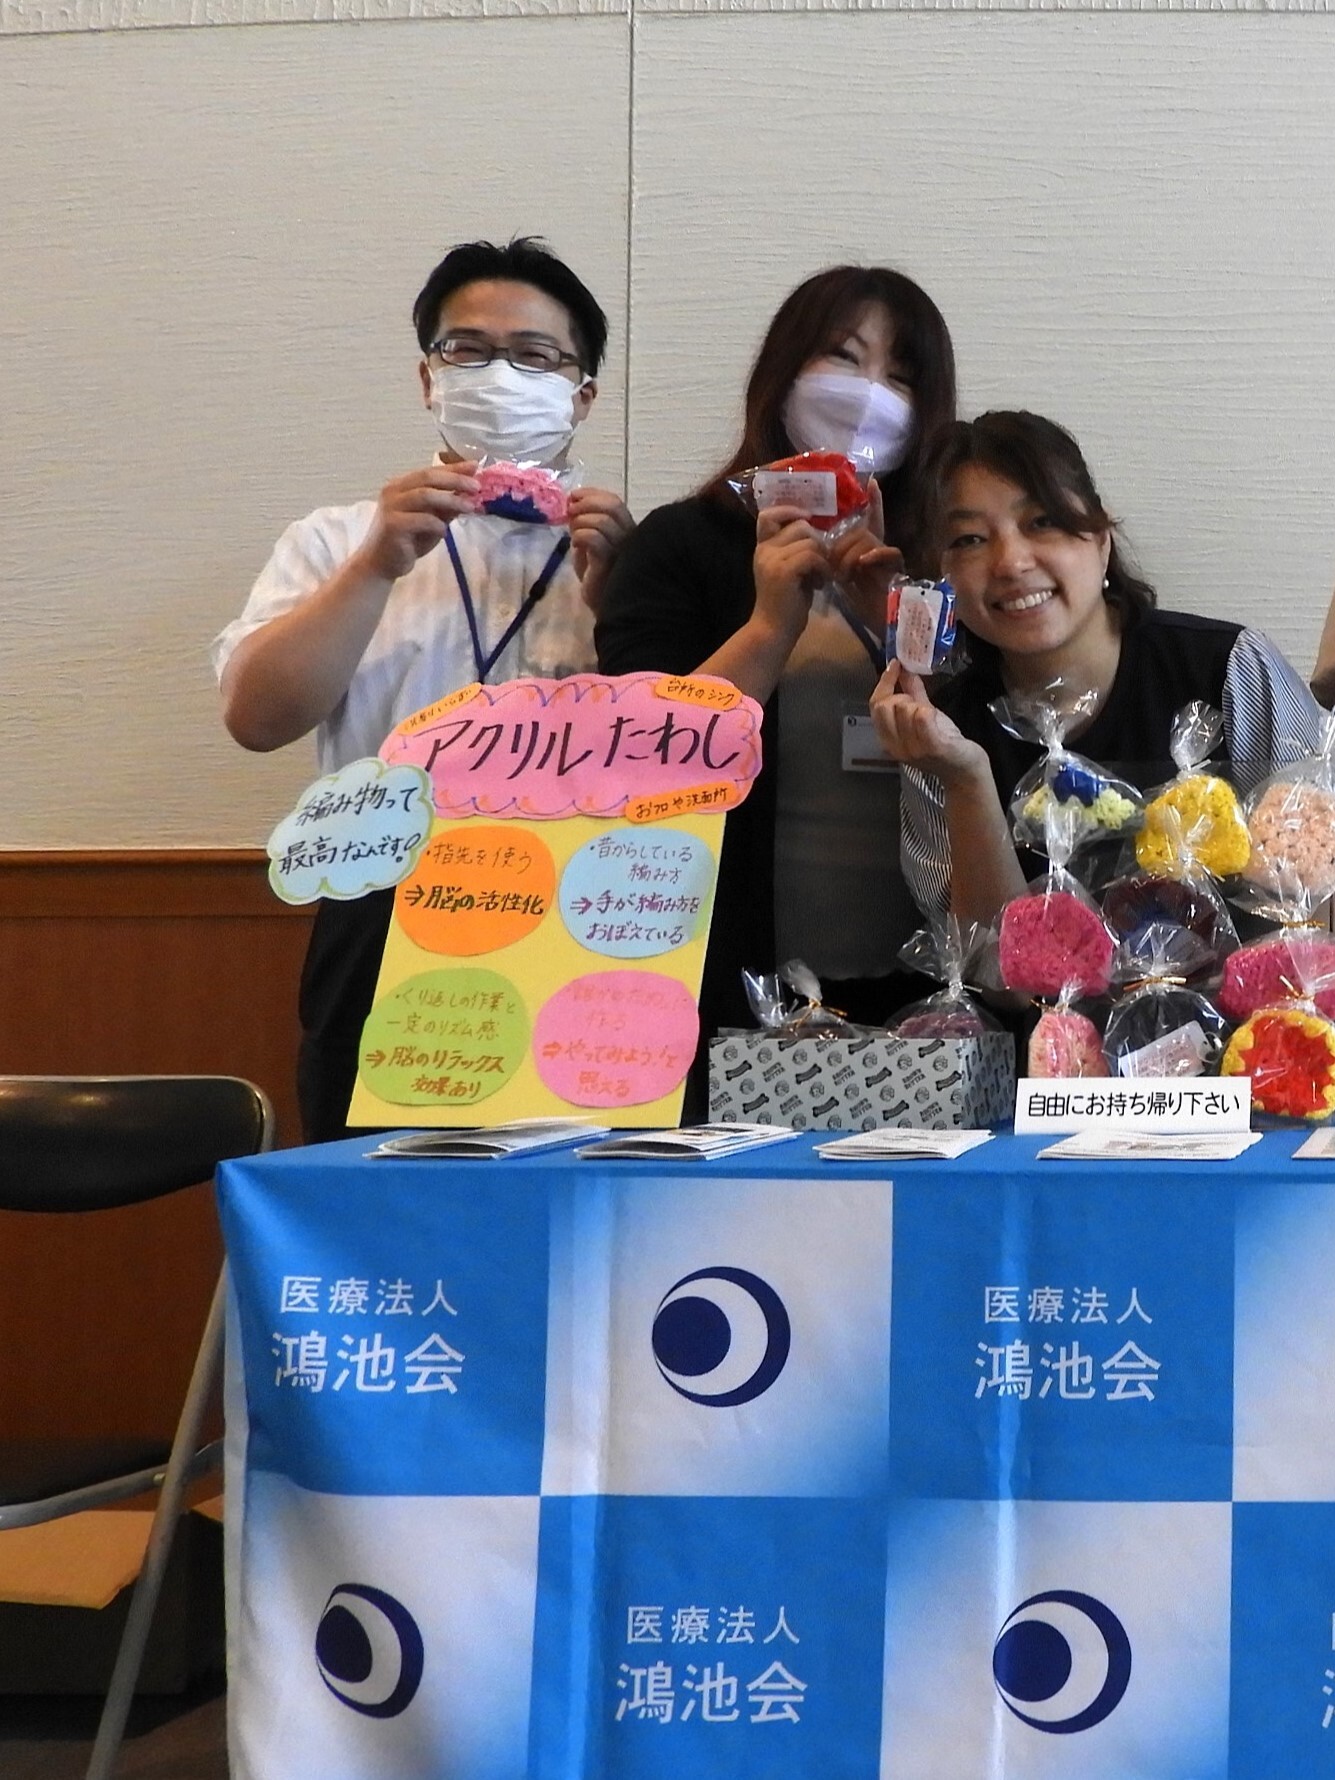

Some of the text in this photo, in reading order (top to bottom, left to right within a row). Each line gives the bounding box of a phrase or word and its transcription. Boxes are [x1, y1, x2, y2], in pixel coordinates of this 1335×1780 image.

[297, 782, 418, 825] 編み物って
[1028, 1091, 1240, 1117] 自由にお持ち帰り下さい
[280, 1275, 458, 1317] 医療法人
[983, 1286, 1153, 1325] 医療法人
[271, 1330, 465, 1395] 鴻池会
[974, 1340, 1161, 1401] 鴻池会
[626, 1606, 800, 1645] 医療法人
[615, 1661, 807, 1723] 鴻池会
